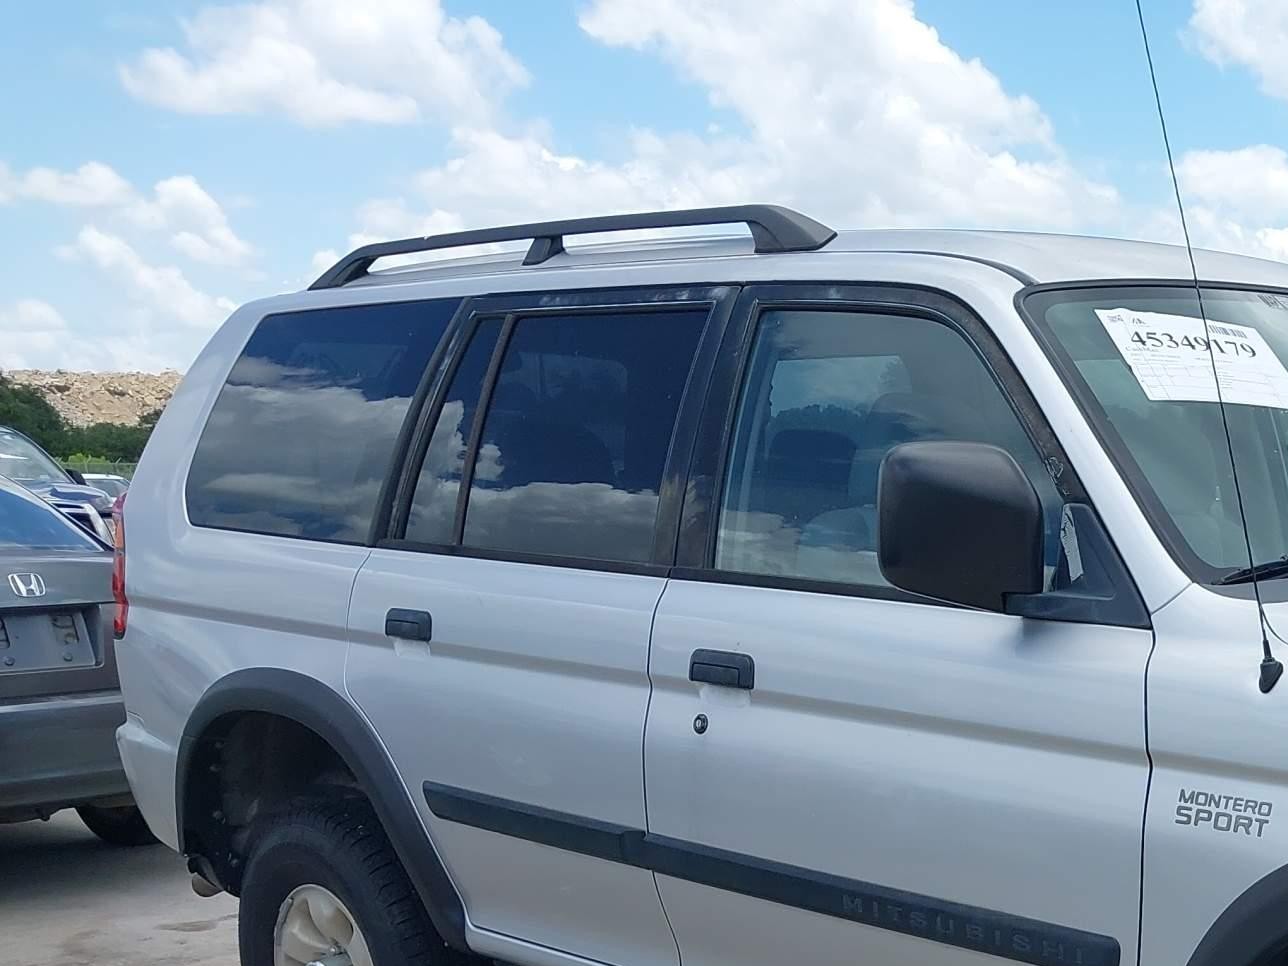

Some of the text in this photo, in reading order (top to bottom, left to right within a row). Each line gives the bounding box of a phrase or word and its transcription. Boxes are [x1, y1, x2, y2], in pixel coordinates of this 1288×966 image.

[1130, 331, 1257, 358] 45349179
[1178, 788, 1273, 817] MONTERO
[1174, 805, 1270, 838] SPORT
[840, 894, 1085, 965] MITSUBISHI
